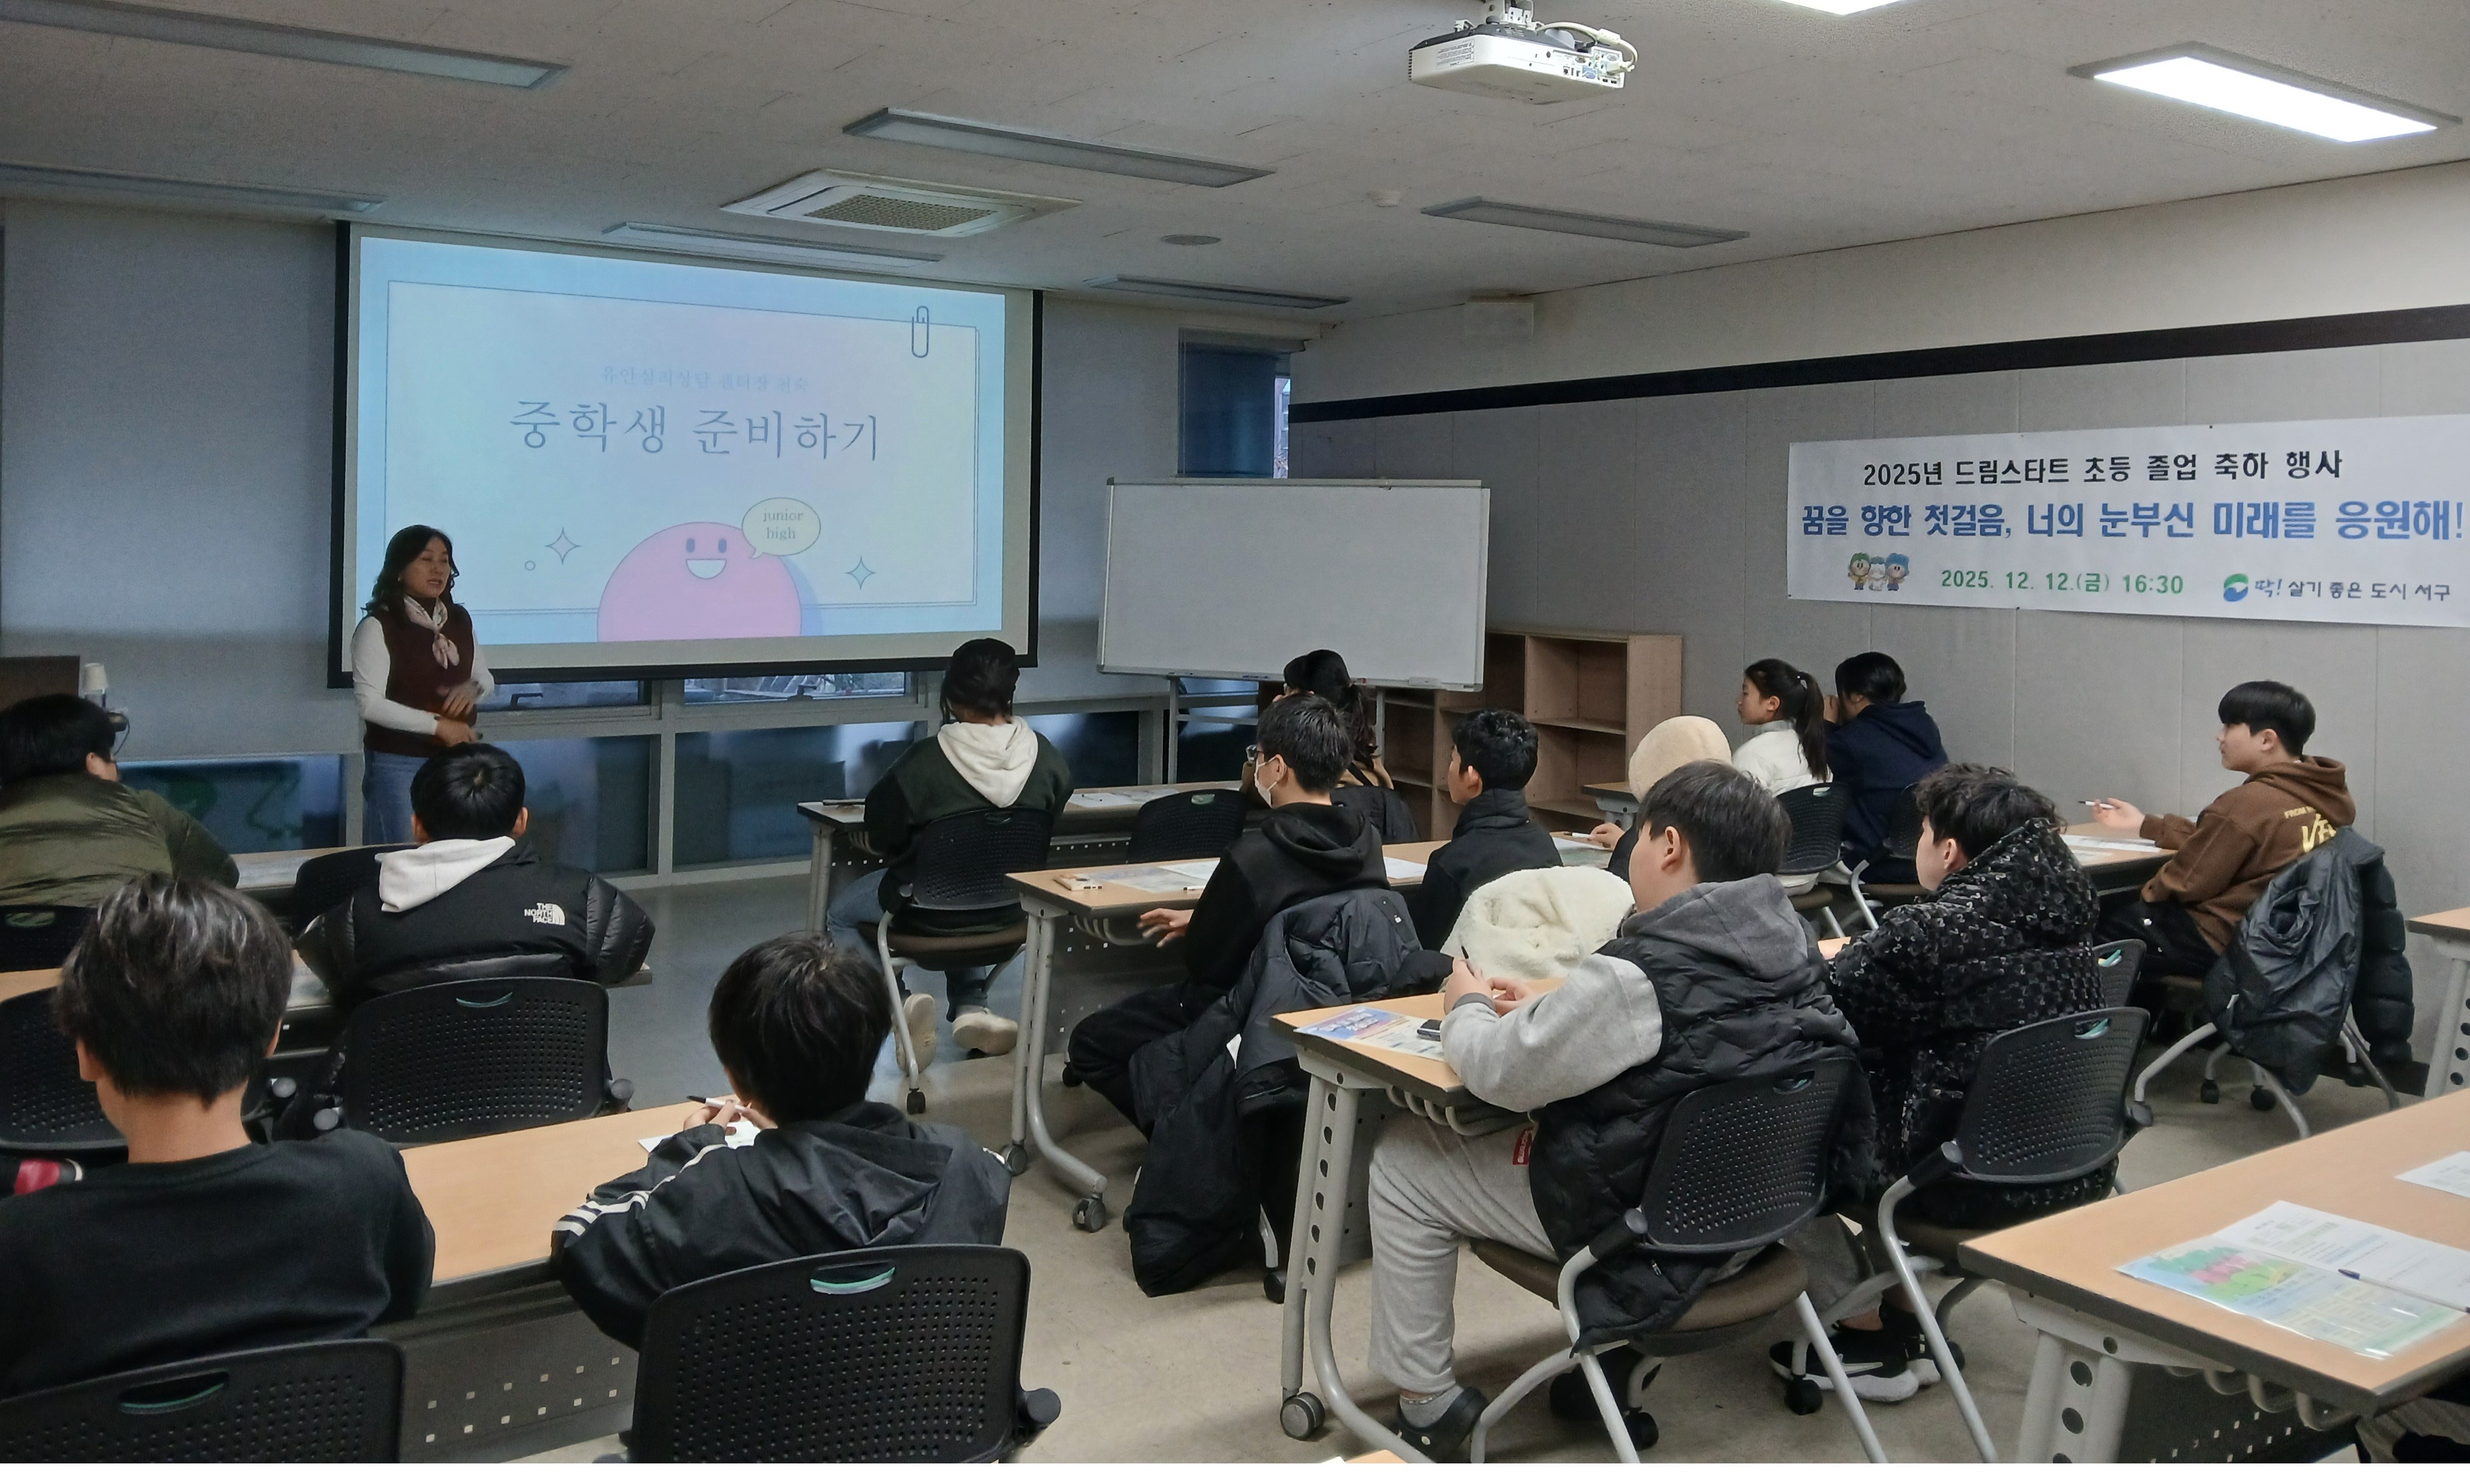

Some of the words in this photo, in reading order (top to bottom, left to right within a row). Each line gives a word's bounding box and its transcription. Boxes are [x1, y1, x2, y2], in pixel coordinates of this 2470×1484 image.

[509, 401, 665, 454] 중학생
[692, 410, 877, 462] 준비하기
[1864, 461, 1943, 486] 2025년
[1955, 458, 2069, 485] 드림스타트
[2083, 456, 2131, 482] 초등
[2147, 454, 2196, 481] 졸업
[2214, 451, 2269, 481] 축하
[2286, 450, 2343, 479] 행사
[762, 507, 805, 523] junior
[1802, 505, 1849, 536] 꿈을
[1860, 505, 1912, 537] 향한
[1924, 504, 2011, 538] 첫걸음,
[2027, 503, 2084, 537] 너의
[2099, 502, 2194, 538] 눈부신
[2213, 502, 2316, 539] 미래를
[2335, 500, 2463, 540] 응원해!
[765, 526, 797, 541] high
[1941, 570, 1994, 588] 2025.
[2005, 571, 2034, 589] 12.
[2123, 574, 2184, 594] 16:30
[2254, 578, 2283, 598] 딱!
[2288, 580, 2322, 598] 살기
[2329, 581, 2362, 599] 좋은
[2370, 583, 2406, 600] 도시
[2414, 584, 2451, 602] 서구
